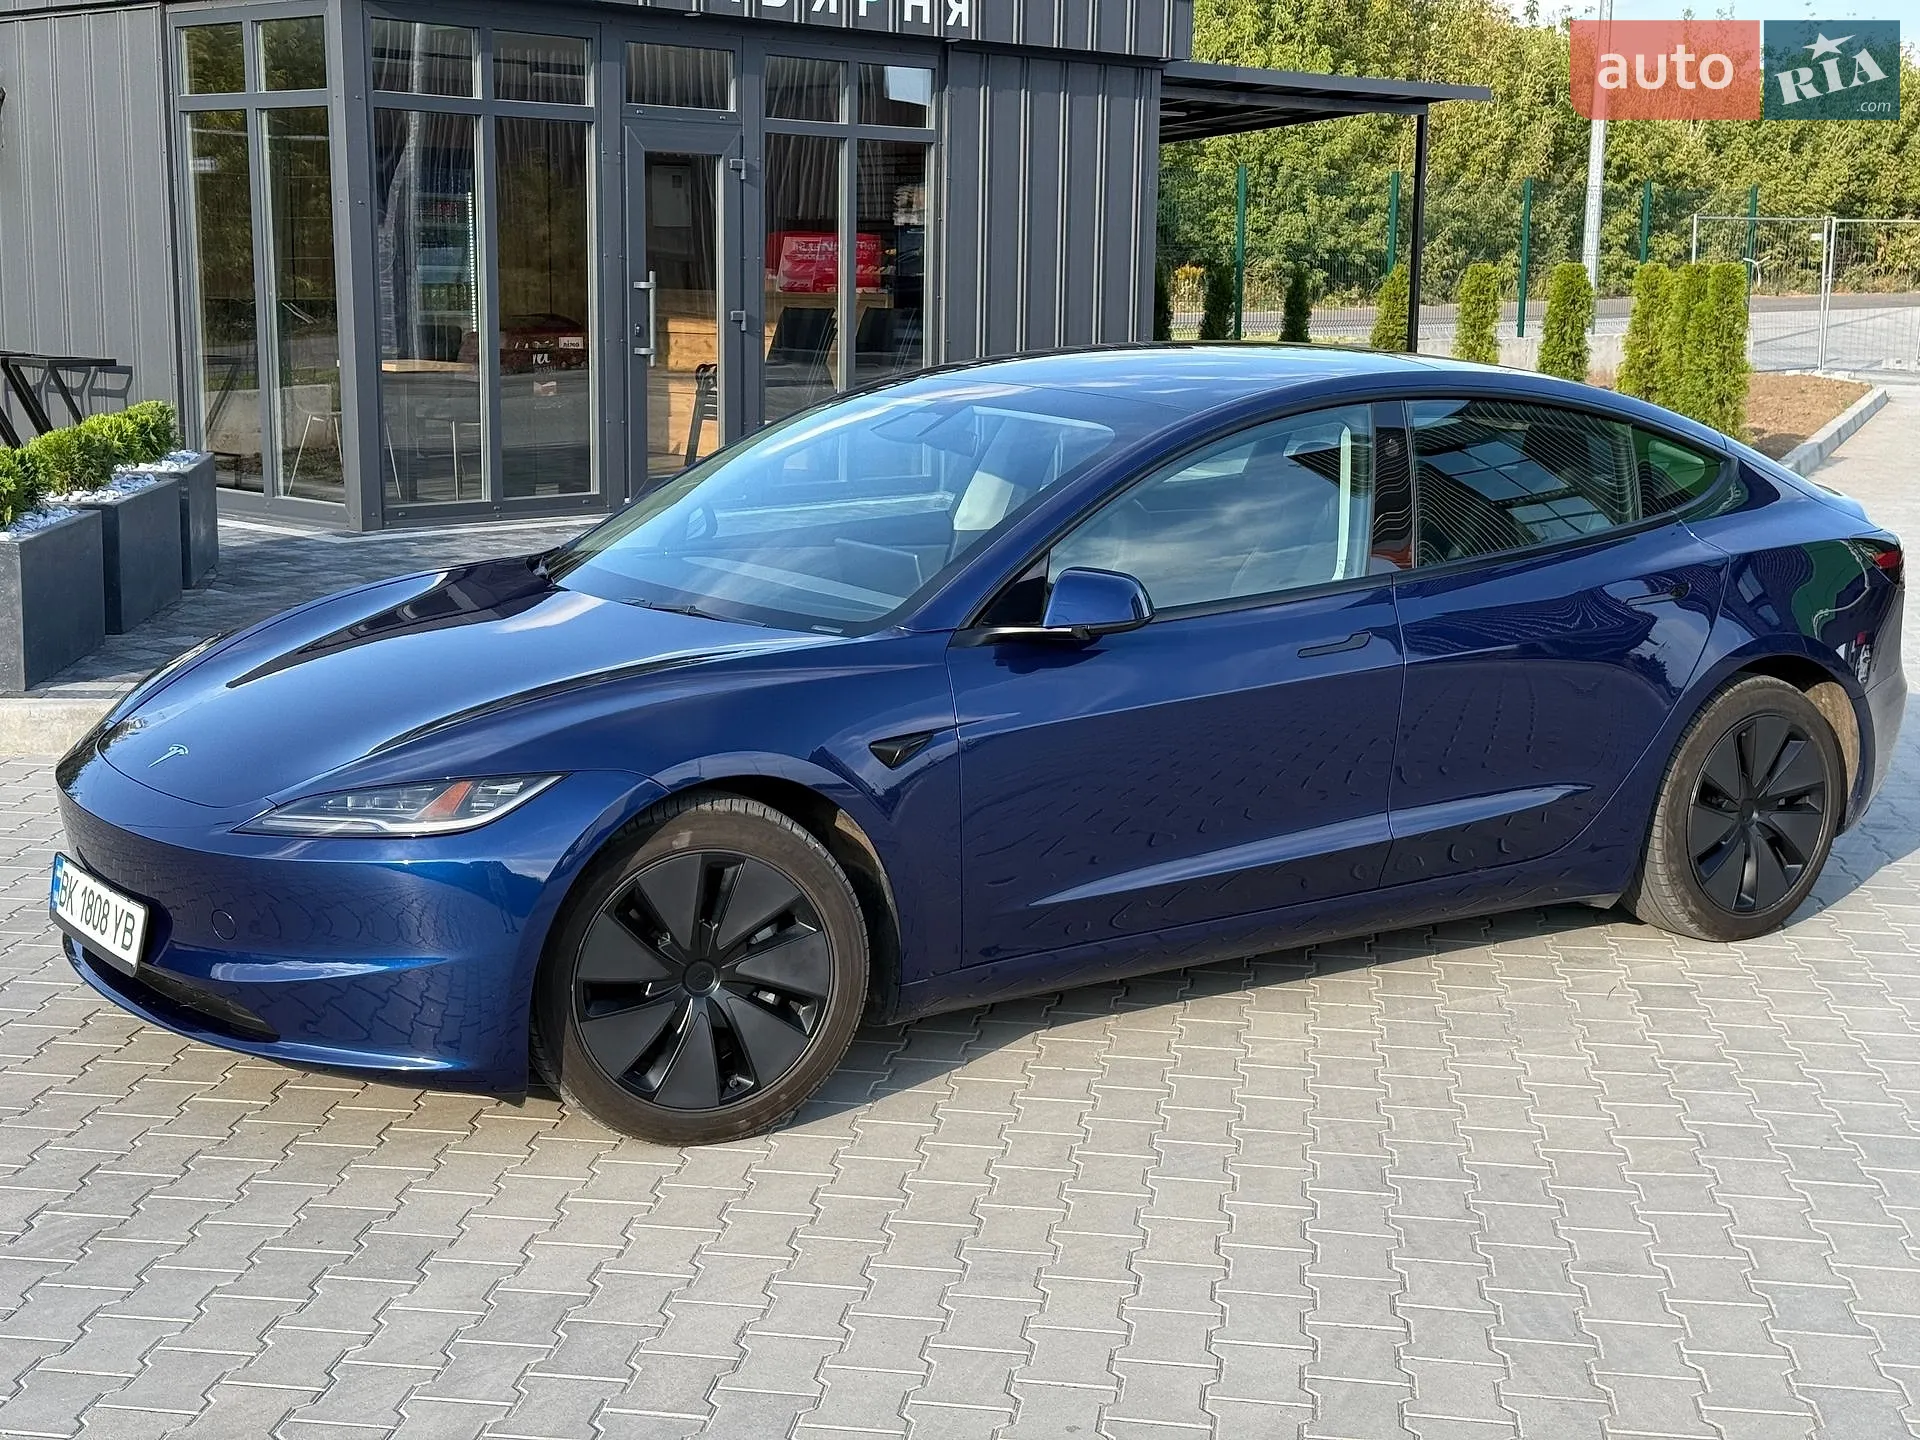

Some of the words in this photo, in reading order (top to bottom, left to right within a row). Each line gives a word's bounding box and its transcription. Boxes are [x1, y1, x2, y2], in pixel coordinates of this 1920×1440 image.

[59, 870, 79, 916] BK
[80, 886, 110, 936] 1808
[113, 904, 135, 951] YB
